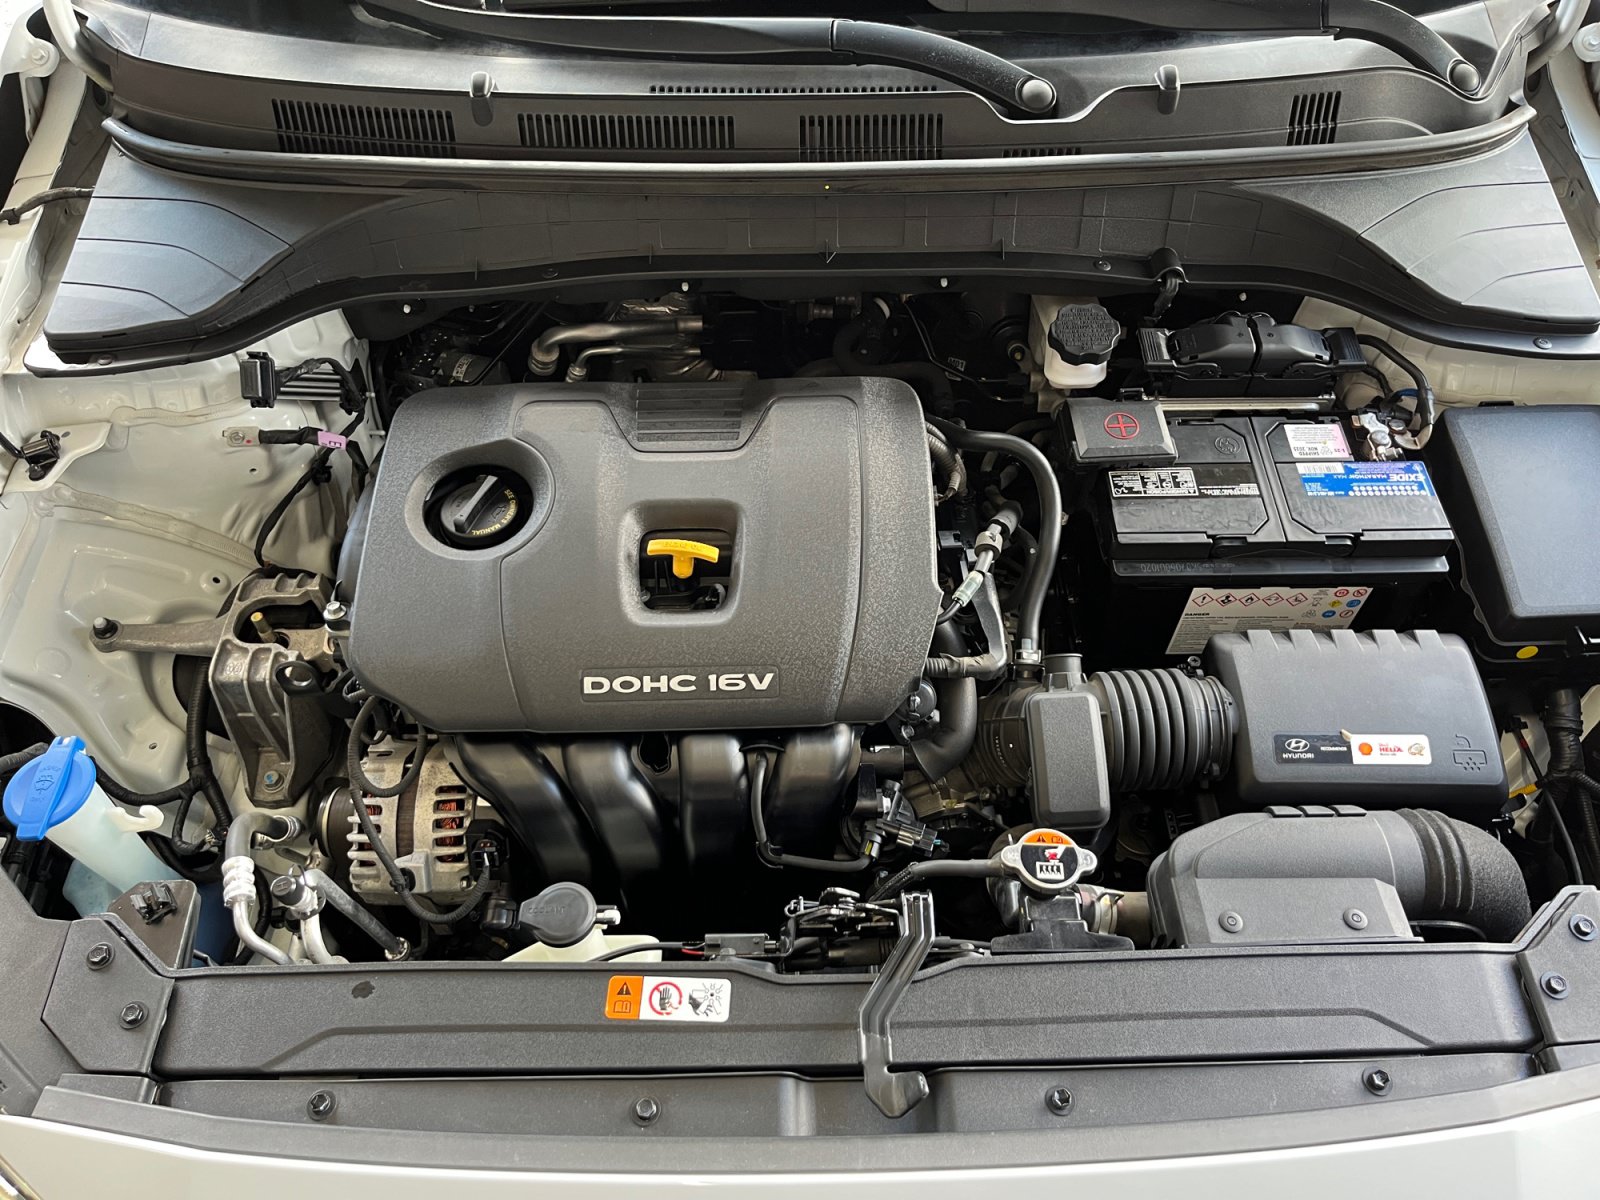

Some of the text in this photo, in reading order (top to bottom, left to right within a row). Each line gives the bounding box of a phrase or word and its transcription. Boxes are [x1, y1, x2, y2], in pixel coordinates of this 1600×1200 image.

[1389, 473, 1425, 482] EXIDE
[472, 523, 502, 536] MANUAL
[583, 672, 775, 694] DOHC 16V
